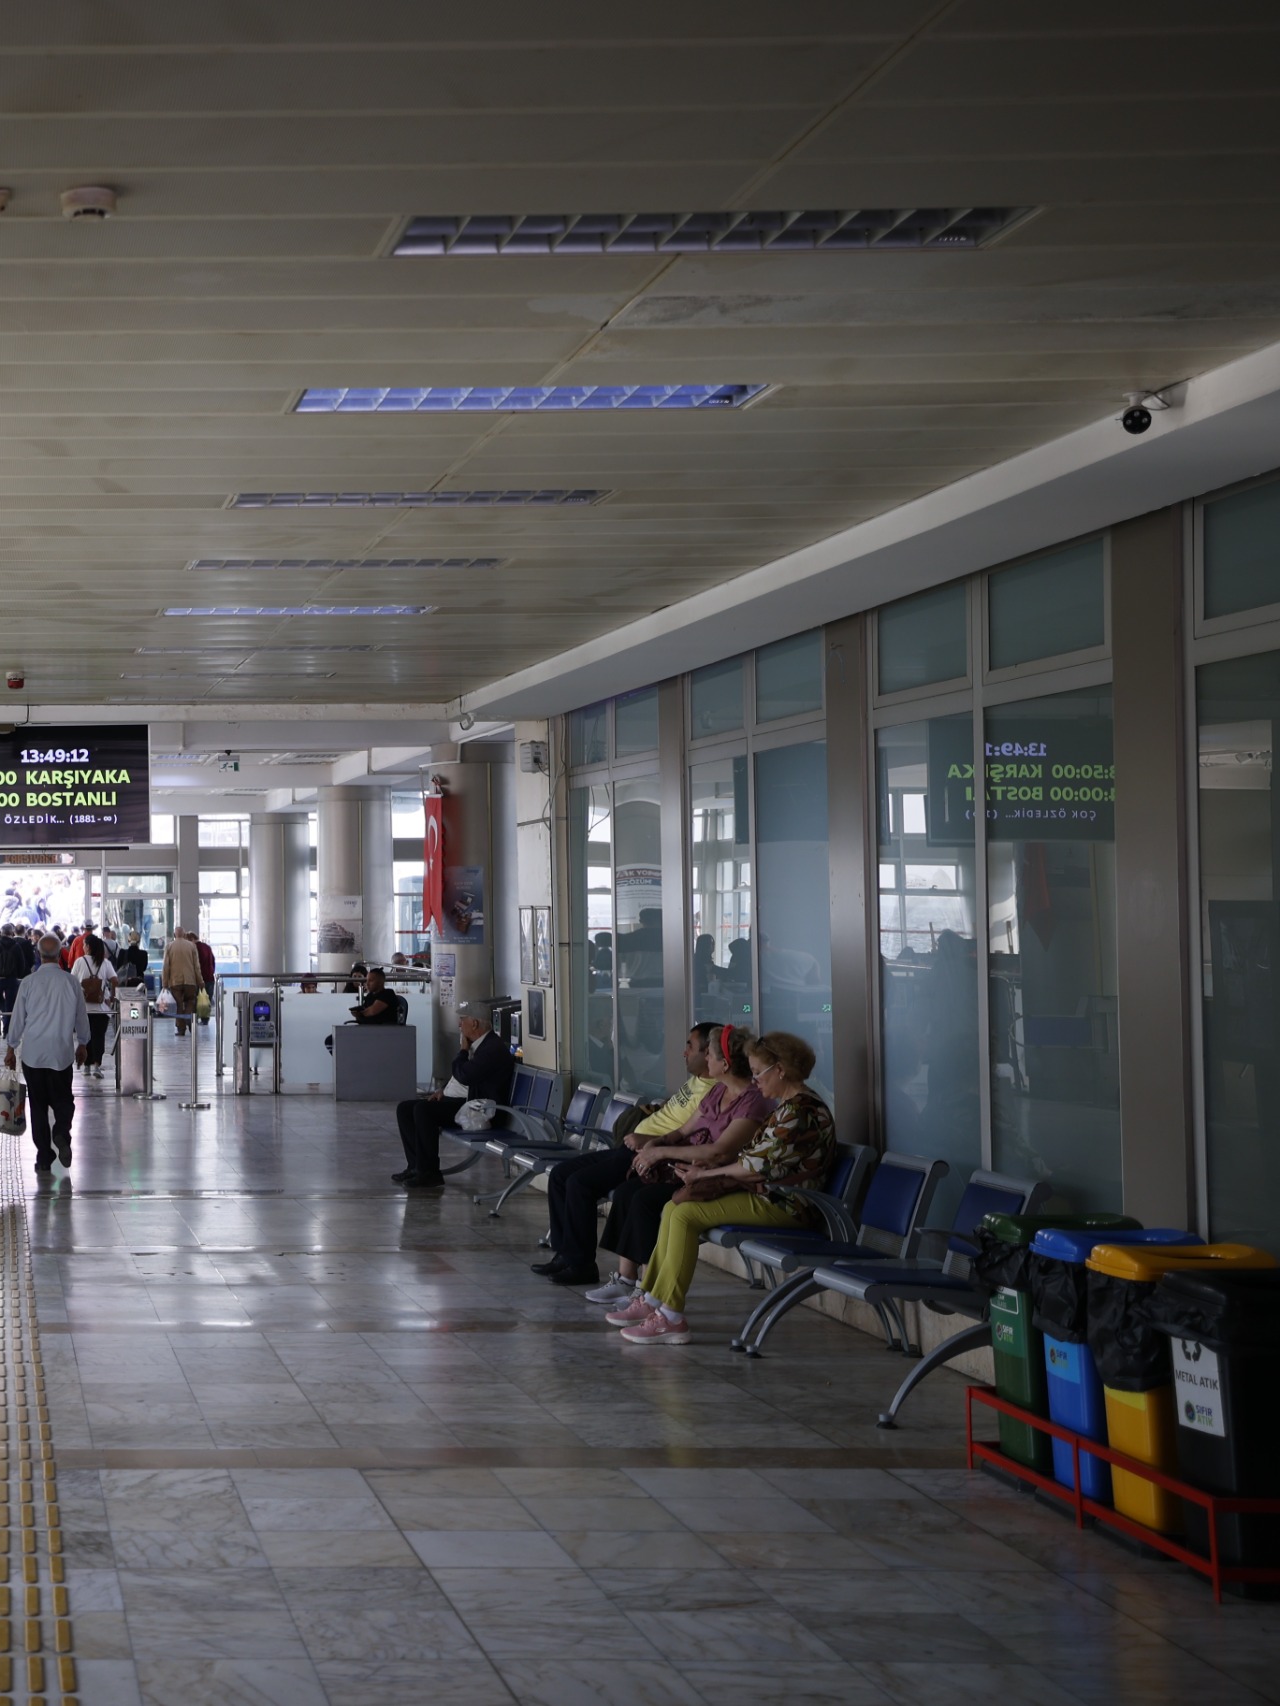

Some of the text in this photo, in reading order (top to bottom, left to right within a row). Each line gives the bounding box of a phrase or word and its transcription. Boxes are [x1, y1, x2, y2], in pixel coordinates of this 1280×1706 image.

[20, 748, 89, 763] 13:49:12
[25, 769, 131, 788] KARŞIYAKA
[26, 791, 117, 807] BOSTANLI
[4, 813, 65, 824] ÖZLEDİK...
[1175, 1369, 1219, 1391] METAL ATIK
[1195, 1404, 1213, 1417] SIFIR
[1197, 1415, 1213, 1428] ATIK
